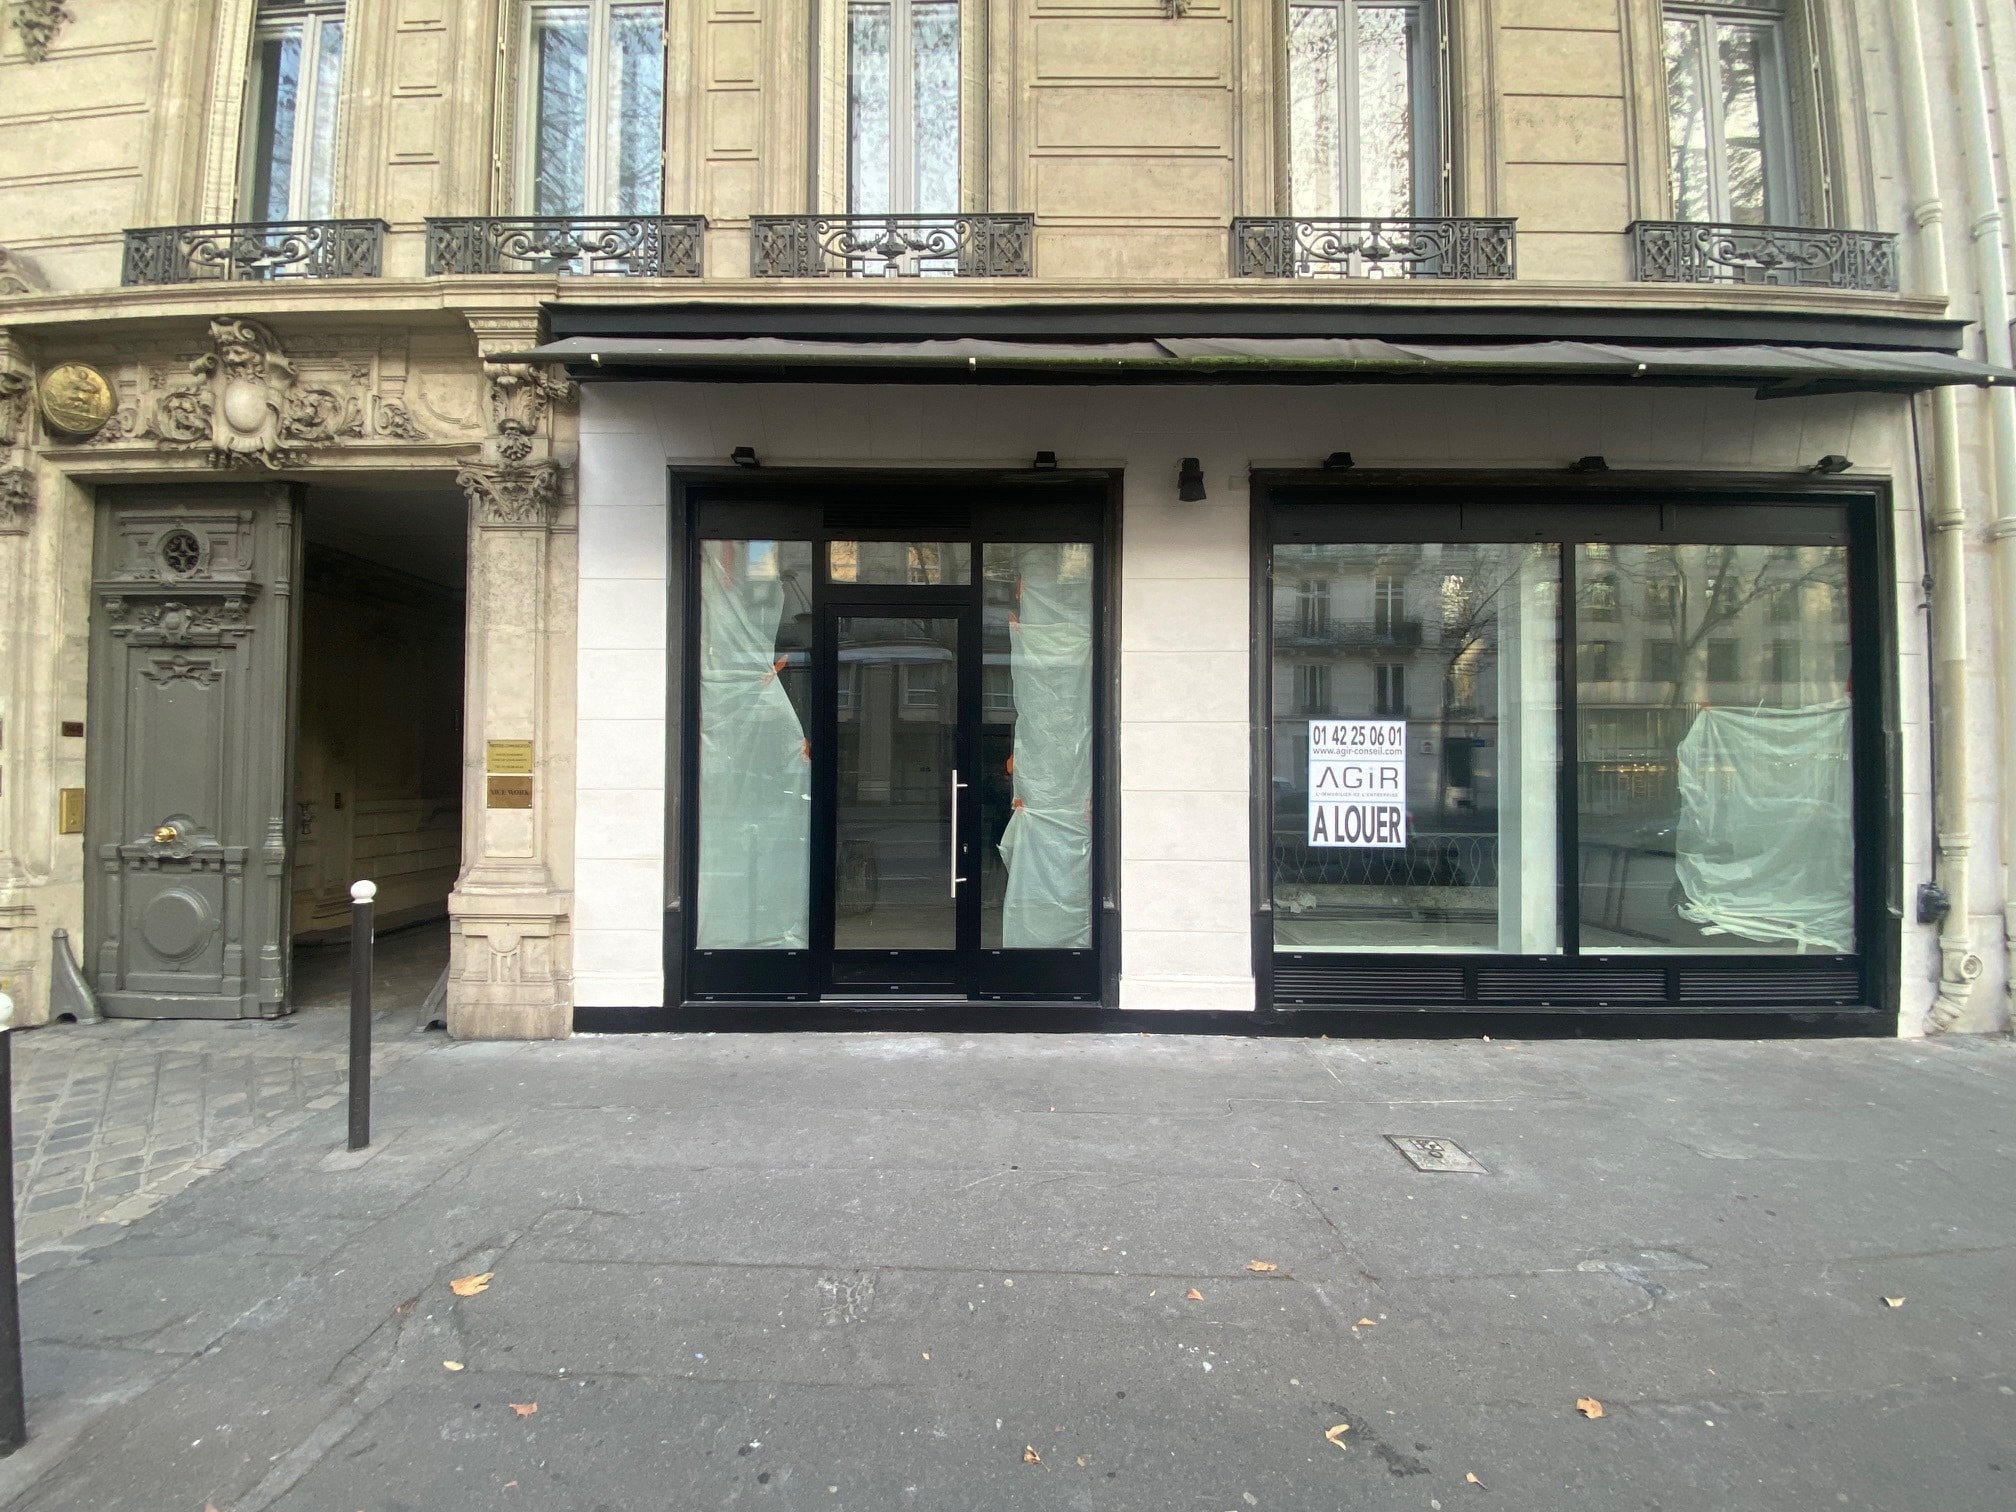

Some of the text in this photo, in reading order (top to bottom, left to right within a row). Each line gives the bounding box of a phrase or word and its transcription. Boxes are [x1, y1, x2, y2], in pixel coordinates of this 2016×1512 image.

[1313, 725, 1402, 746] 01 42 25 06 01
[1313, 746, 1402, 756] www.agir-conseil.com
[1313, 805, 1401, 843] A LOUER
